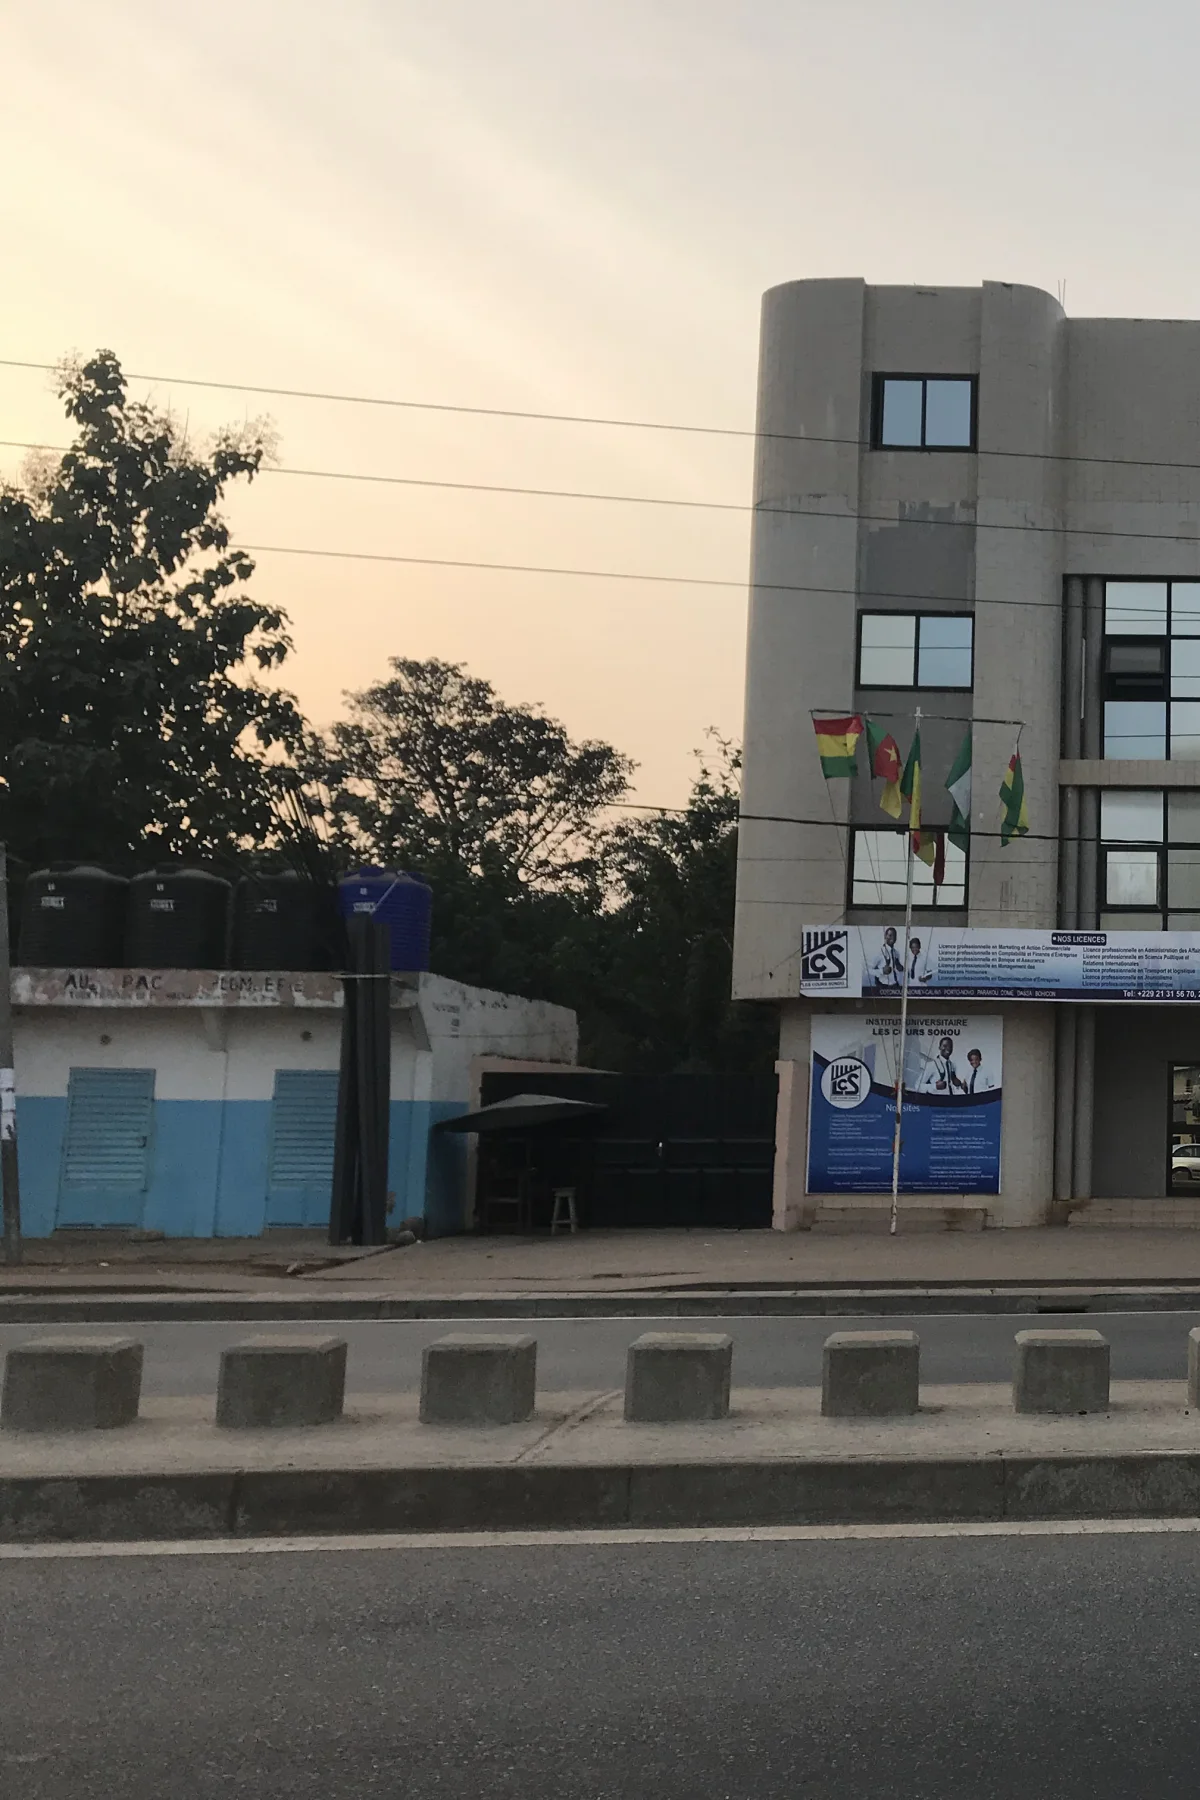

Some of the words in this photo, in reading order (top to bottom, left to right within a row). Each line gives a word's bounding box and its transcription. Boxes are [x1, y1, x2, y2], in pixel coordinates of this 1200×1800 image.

[872, 1028, 890, 1036] LES
[892, 1028, 924, 1036] CURS
[927, 1028, 960, 1036] SONOU
[885, 1104, 898, 1112] No
[903, 1104, 920, 1112] sites
